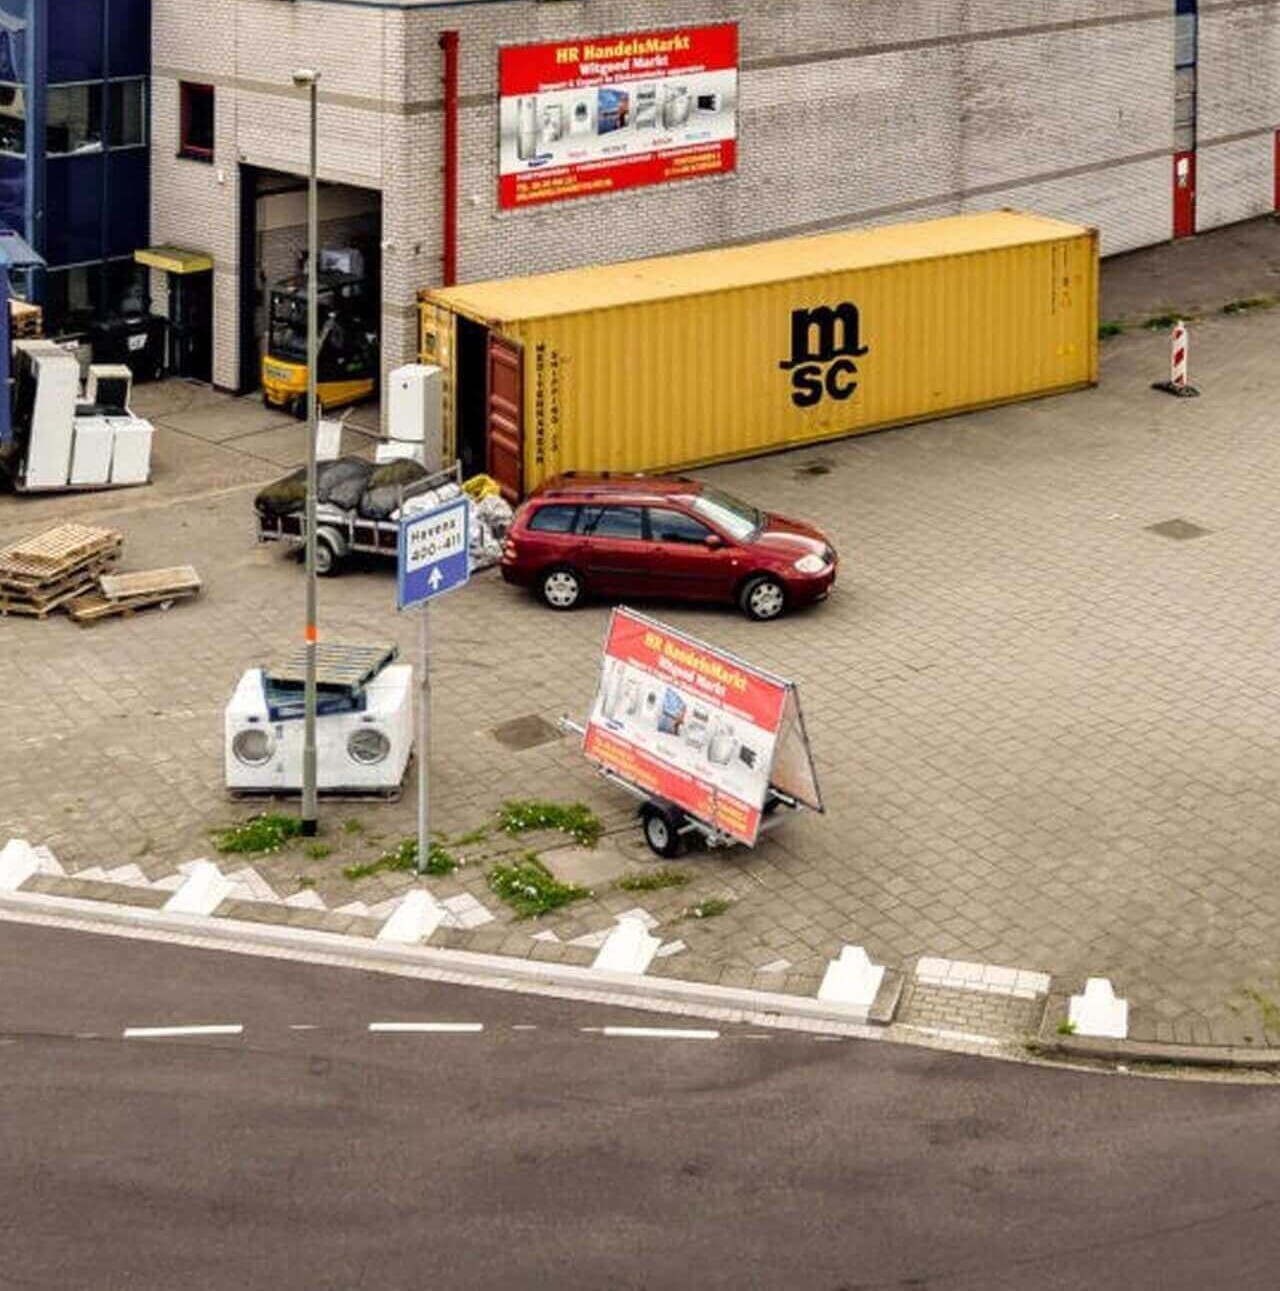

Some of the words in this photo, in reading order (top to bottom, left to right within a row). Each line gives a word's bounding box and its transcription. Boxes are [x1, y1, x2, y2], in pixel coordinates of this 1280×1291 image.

[555, 47, 580, 63] HR
[583, 35, 690, 60] HandelsMarkt
[579, 59, 629, 76] Witgoed
[632, 54, 669, 71] Markt
